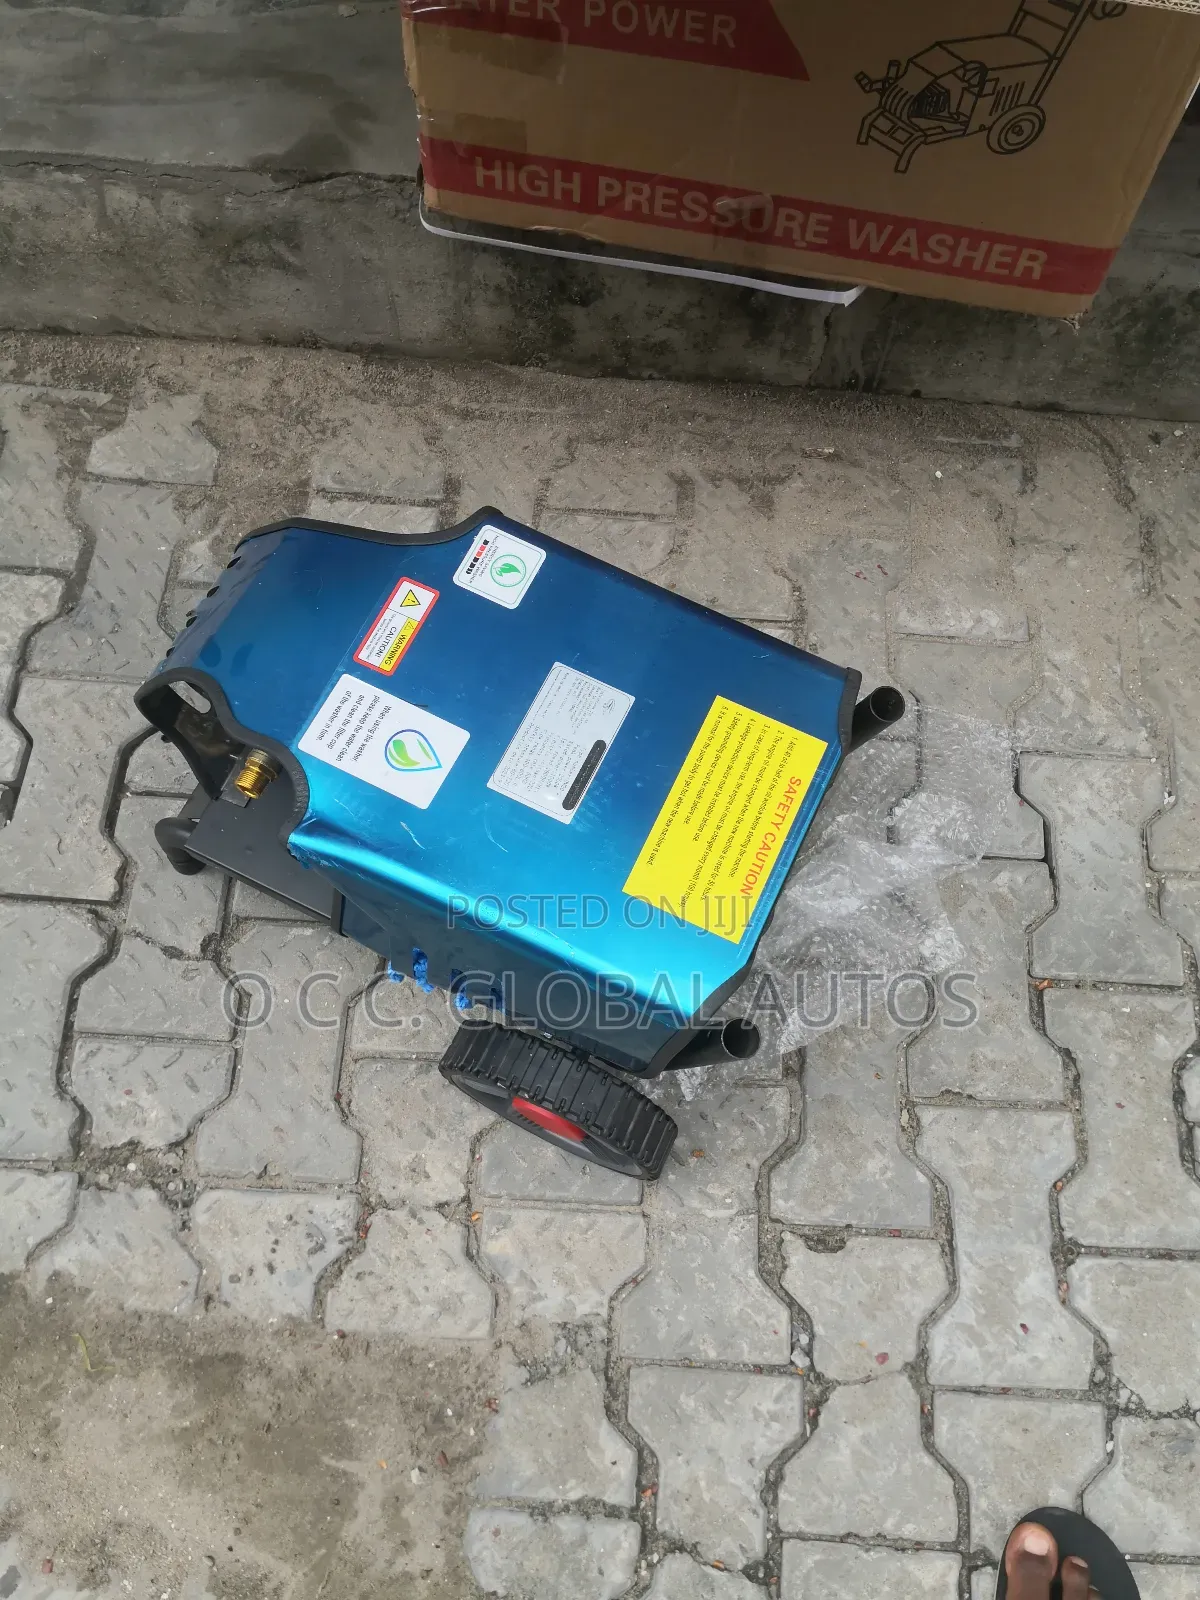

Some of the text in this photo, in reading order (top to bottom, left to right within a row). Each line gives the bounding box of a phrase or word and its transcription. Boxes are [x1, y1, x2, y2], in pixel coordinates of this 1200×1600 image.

[583, 0, 736, 48] POWER
[475, 157, 1049, 280] HIGH PRESSURE WASHER
[374, 625, 397, 658] CAUTION!
[383, 633, 407, 666] WARNING
[338, 695, 349, 705] the
[343, 689, 353, 698] of
[354, 693, 366, 705] and
[327, 704, 344, 724] washer
[345, 703, 359, 719] clean
[377, 704, 392, 721] When
[334, 694, 381, 763] please keep the water clean
[340, 717, 351, 728] the
[366, 718, 382, 735] using
[324, 737, 337, 750] cup
[362, 733, 374, 744] the
[738, 774, 802, 896] SAFETY CAUTION
